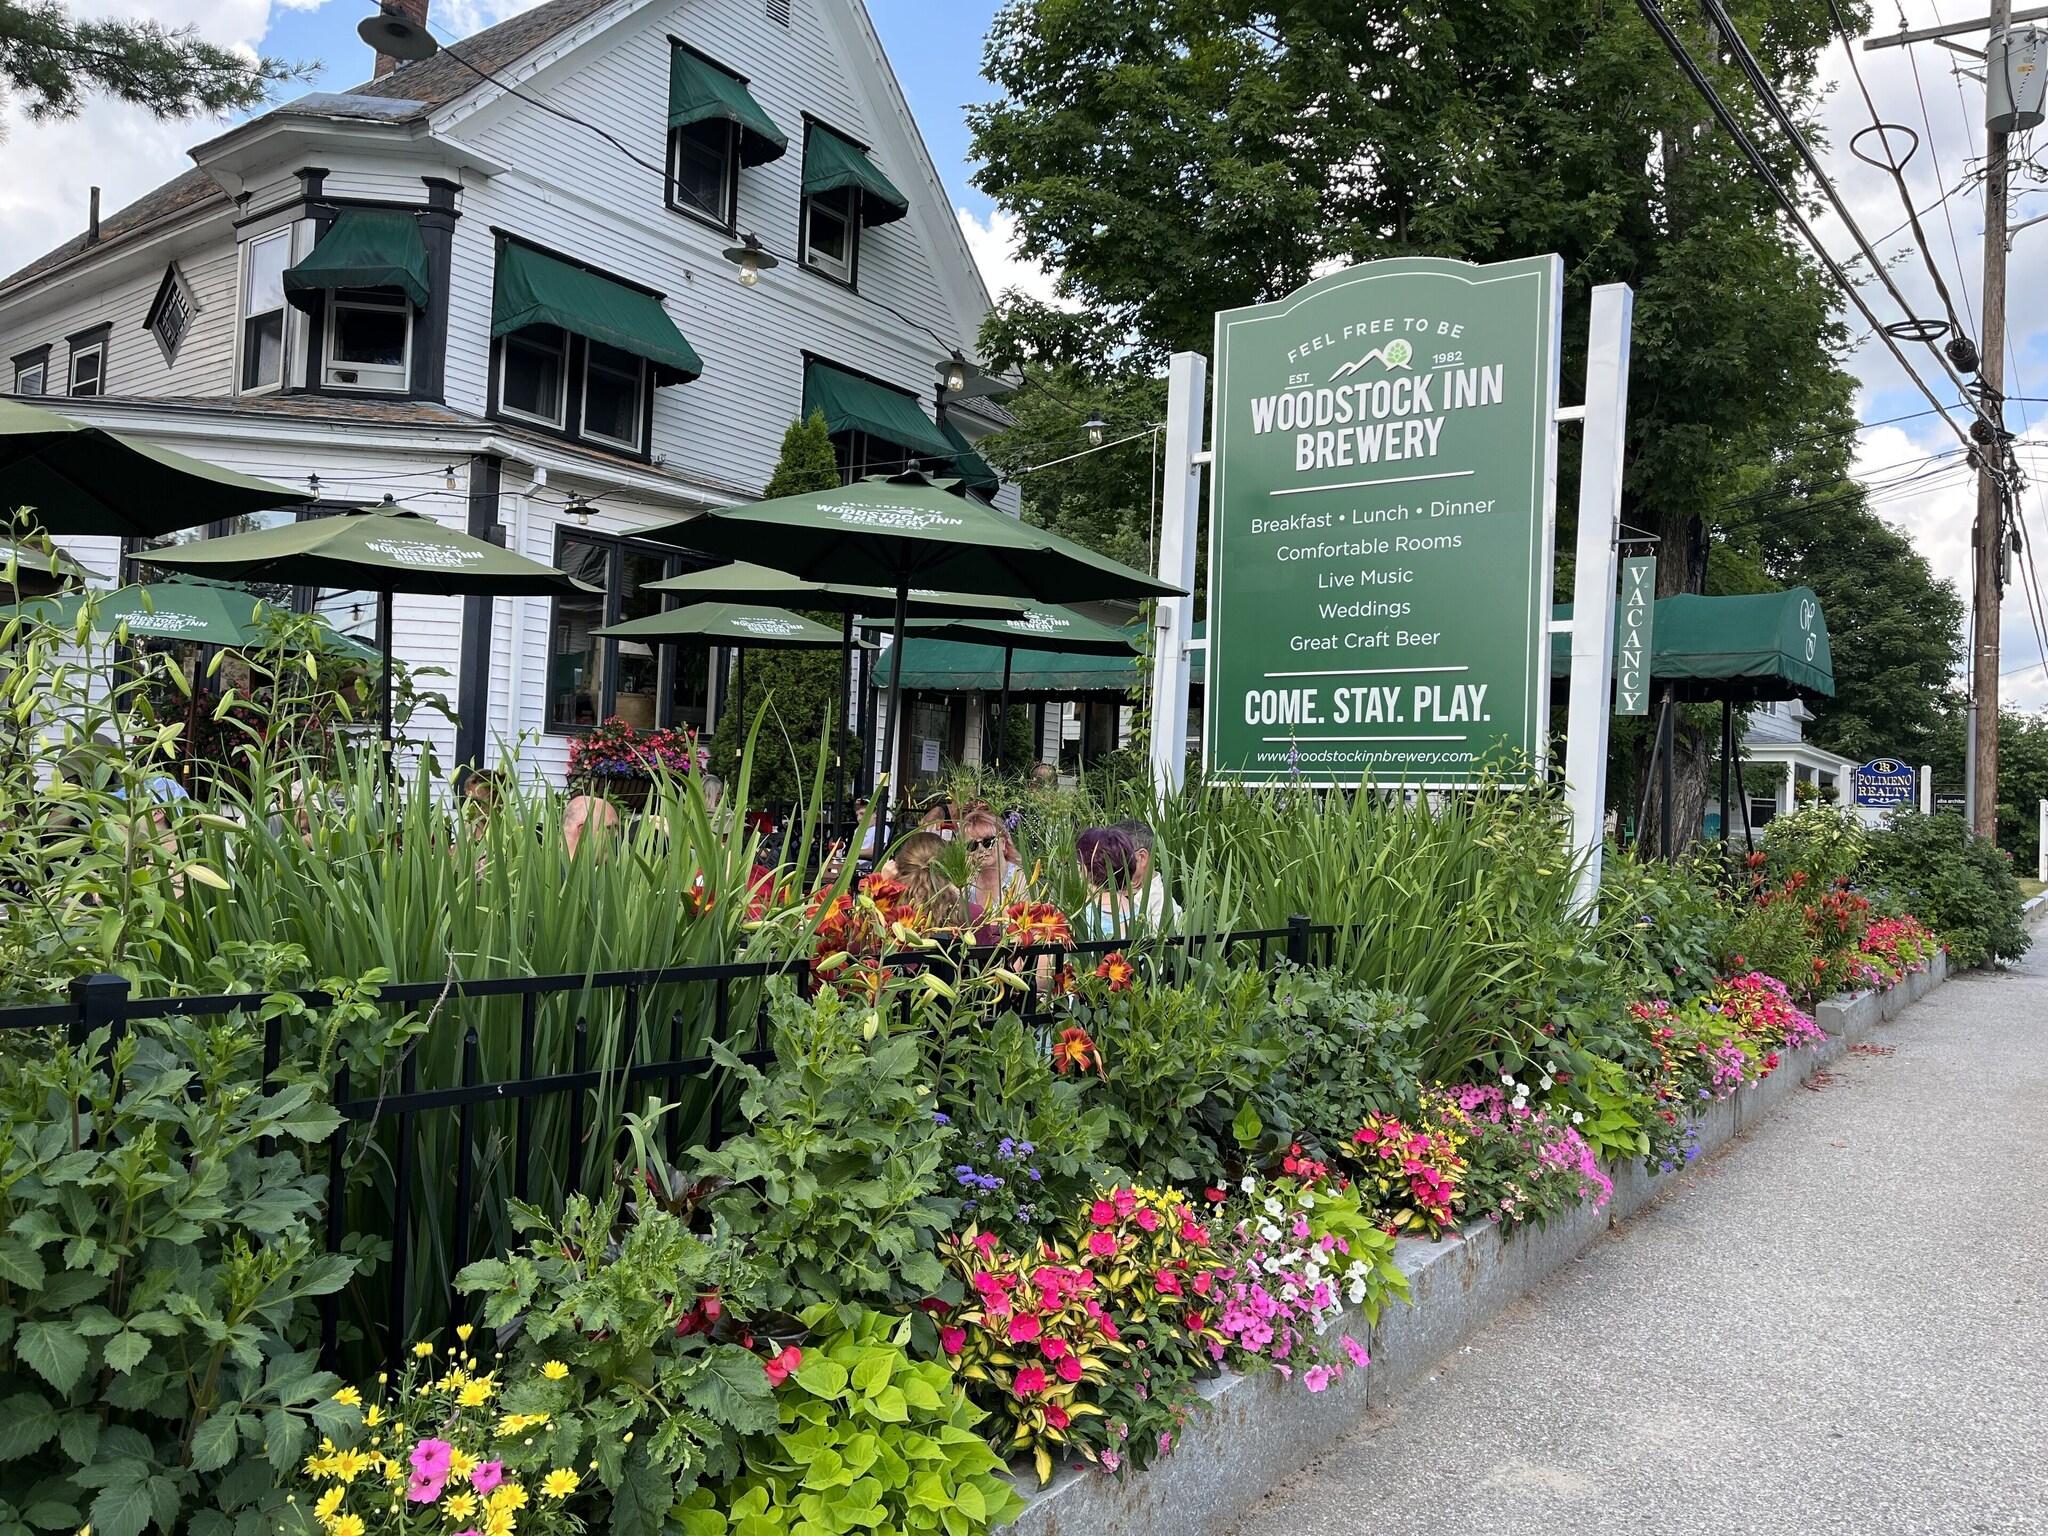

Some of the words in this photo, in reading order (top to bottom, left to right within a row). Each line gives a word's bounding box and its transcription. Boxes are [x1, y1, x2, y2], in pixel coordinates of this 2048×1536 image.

[1287, 333, 1336, 364] FEEL
[1343, 318, 1395, 340] FREE
[1403, 317, 1429, 332] TO
[1436, 320, 1465, 339] BE
[1432, 350, 1464, 364] 1982
[1288, 372, 1310, 385] EST
[1250, 373, 1435, 435] WOODSTOCK
[1443, 363, 1504, 410] INN
[1295, 416, 1446, 472] BREWERY
[816, 504, 925, 521] WOODSTOCK
[929, 516, 963, 525] INN
[840, 514, 930, 527] BREWERY
[1251, 512, 1333, 535] Breakfast
[1352, 504, 1409, 525] Lunch
[1430, 499, 1496, 518] Dinner
[365, 542, 453, 558] WOODSTOCK
[455, 550, 484, 559] INN
[1276, 538, 1389, 562] Comfortable
[1395, 534, 1462, 552] Rooms
[1318, 572, 1355, 589] Live
[1360, 567, 1414, 586] Music
[1318, 600, 1411, 619] Weddings
[1290, 634, 1339, 652] Great
[1344, 631, 1390, 649] Craft
[1396, 629, 1441, 647] Beer
[1620, 566, 1649, 711] VACANCY
[1245, 688, 1325, 725] COME.
[1333, 686, 1404, 724] STAY.
[1413, 684, 1491, 723] PLAY.
[1256, 749, 1473, 764] wwwoodstockinnbrewery.com
[1857, 774, 1912, 786] POLIMENO
[1858, 786, 1912, 797] REALTY
